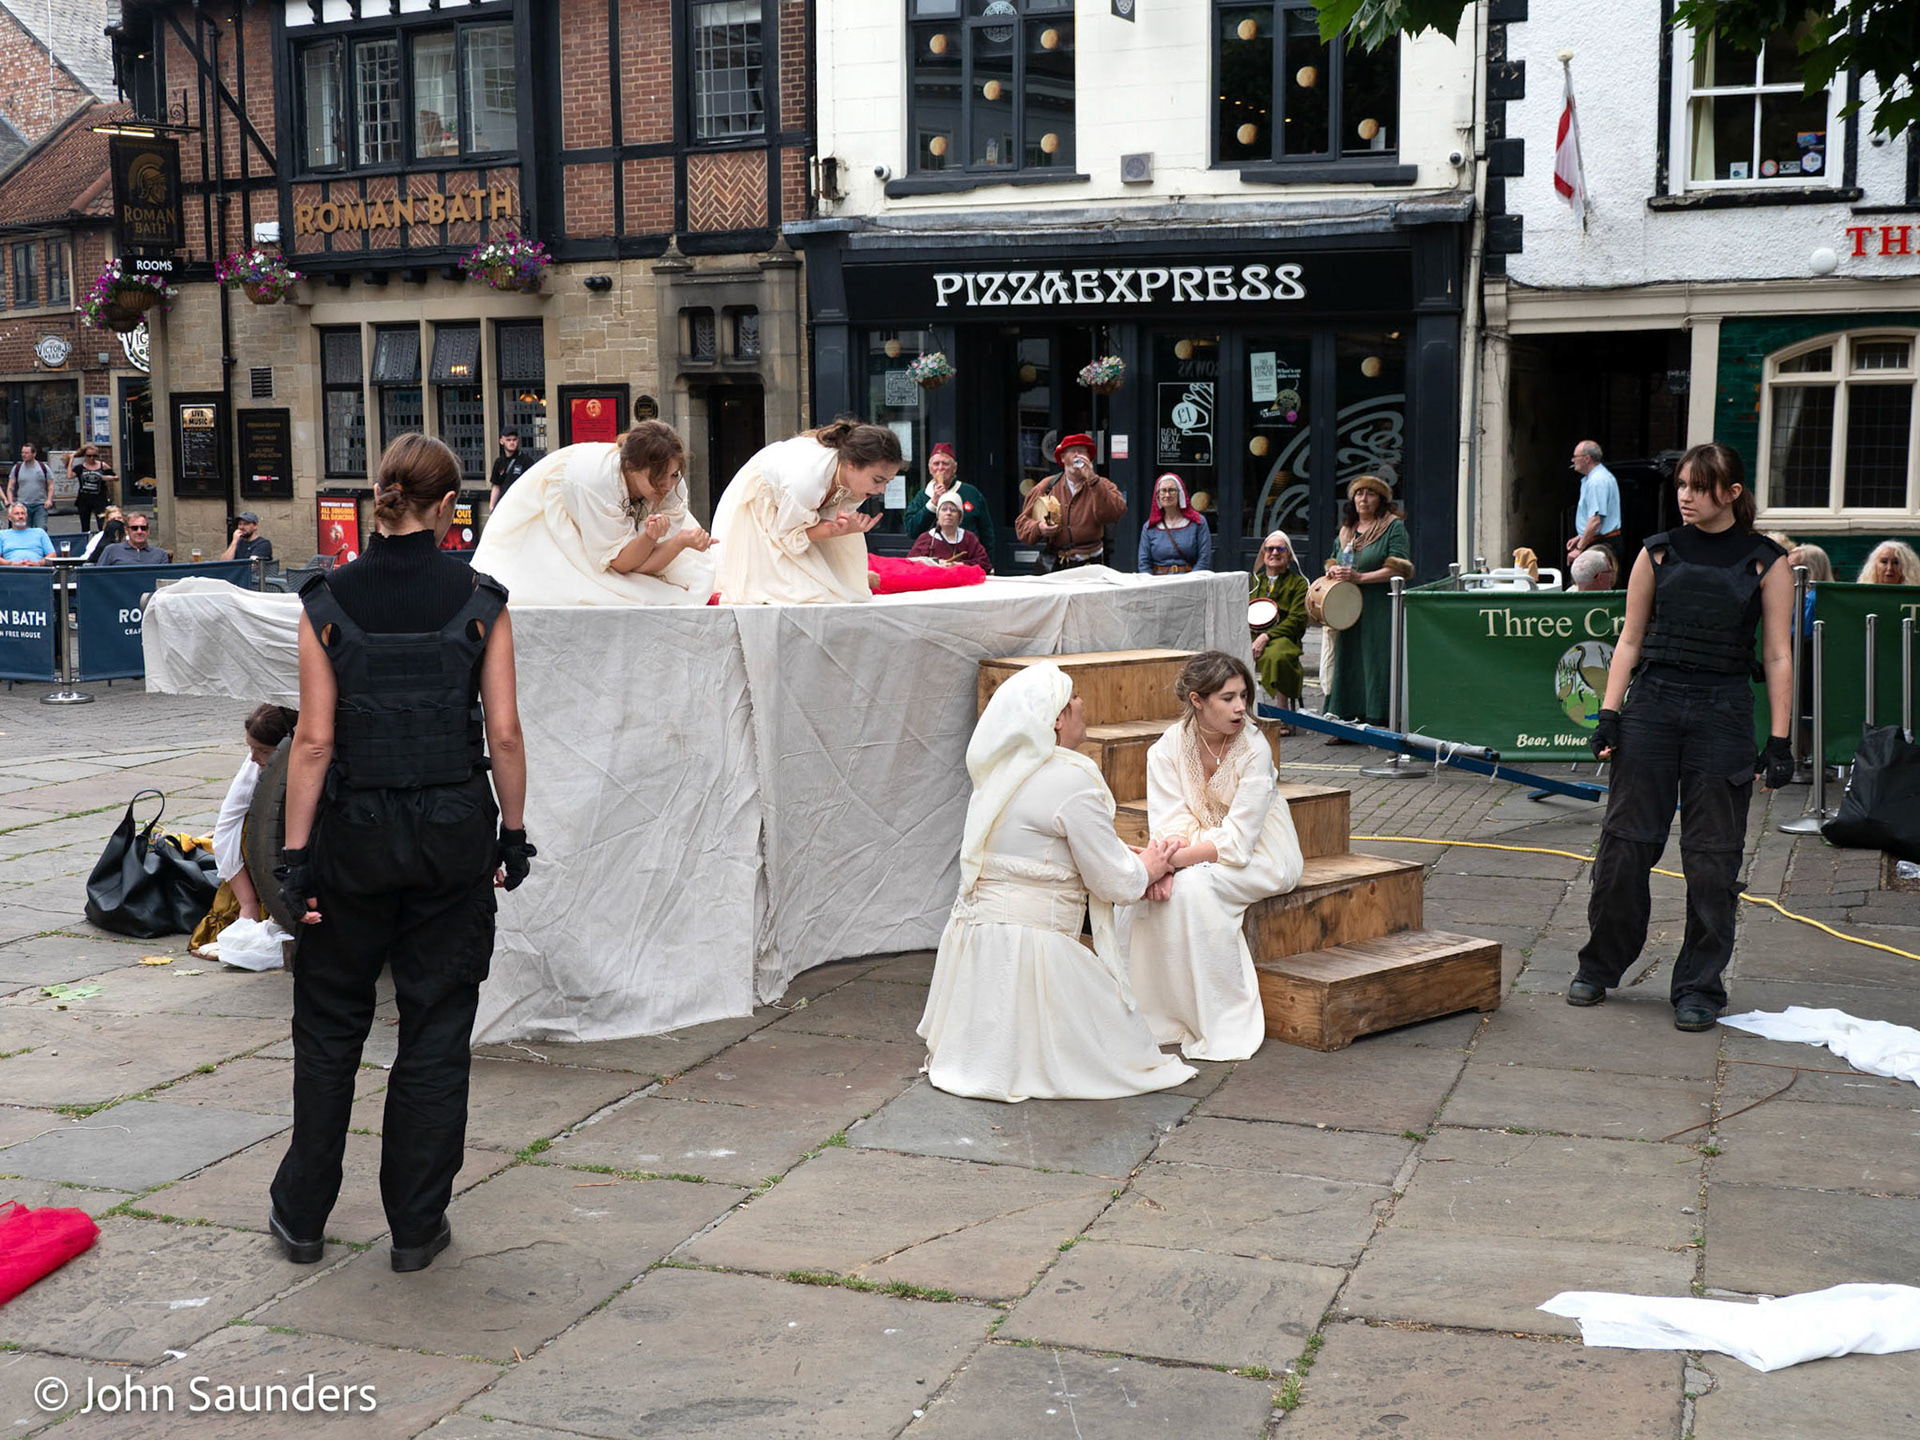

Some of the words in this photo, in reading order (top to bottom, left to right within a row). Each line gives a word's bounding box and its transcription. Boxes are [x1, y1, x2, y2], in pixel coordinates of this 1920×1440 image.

[123, 204, 176, 224] ROMAN
[297, 195, 415, 235] ROMAN
[428, 187, 512, 225] BATH
[135, 222, 168, 234] BATH
[1846, 225, 1920, 256] TH
[136, 260, 173, 271] ROOMS
[933, 264, 1306, 306] PIZZAEXPRESS
[456, 510, 472, 518] OUT
[12, 611, 46, 626] BATH
[119, 608, 142, 623] RO
[1479, 608, 1573, 637] Three
[1584, 607, 1625, 637] Cr
[1516, 733, 1551, 748] Beer,
[1554, 733, 1593, 746] Wine
